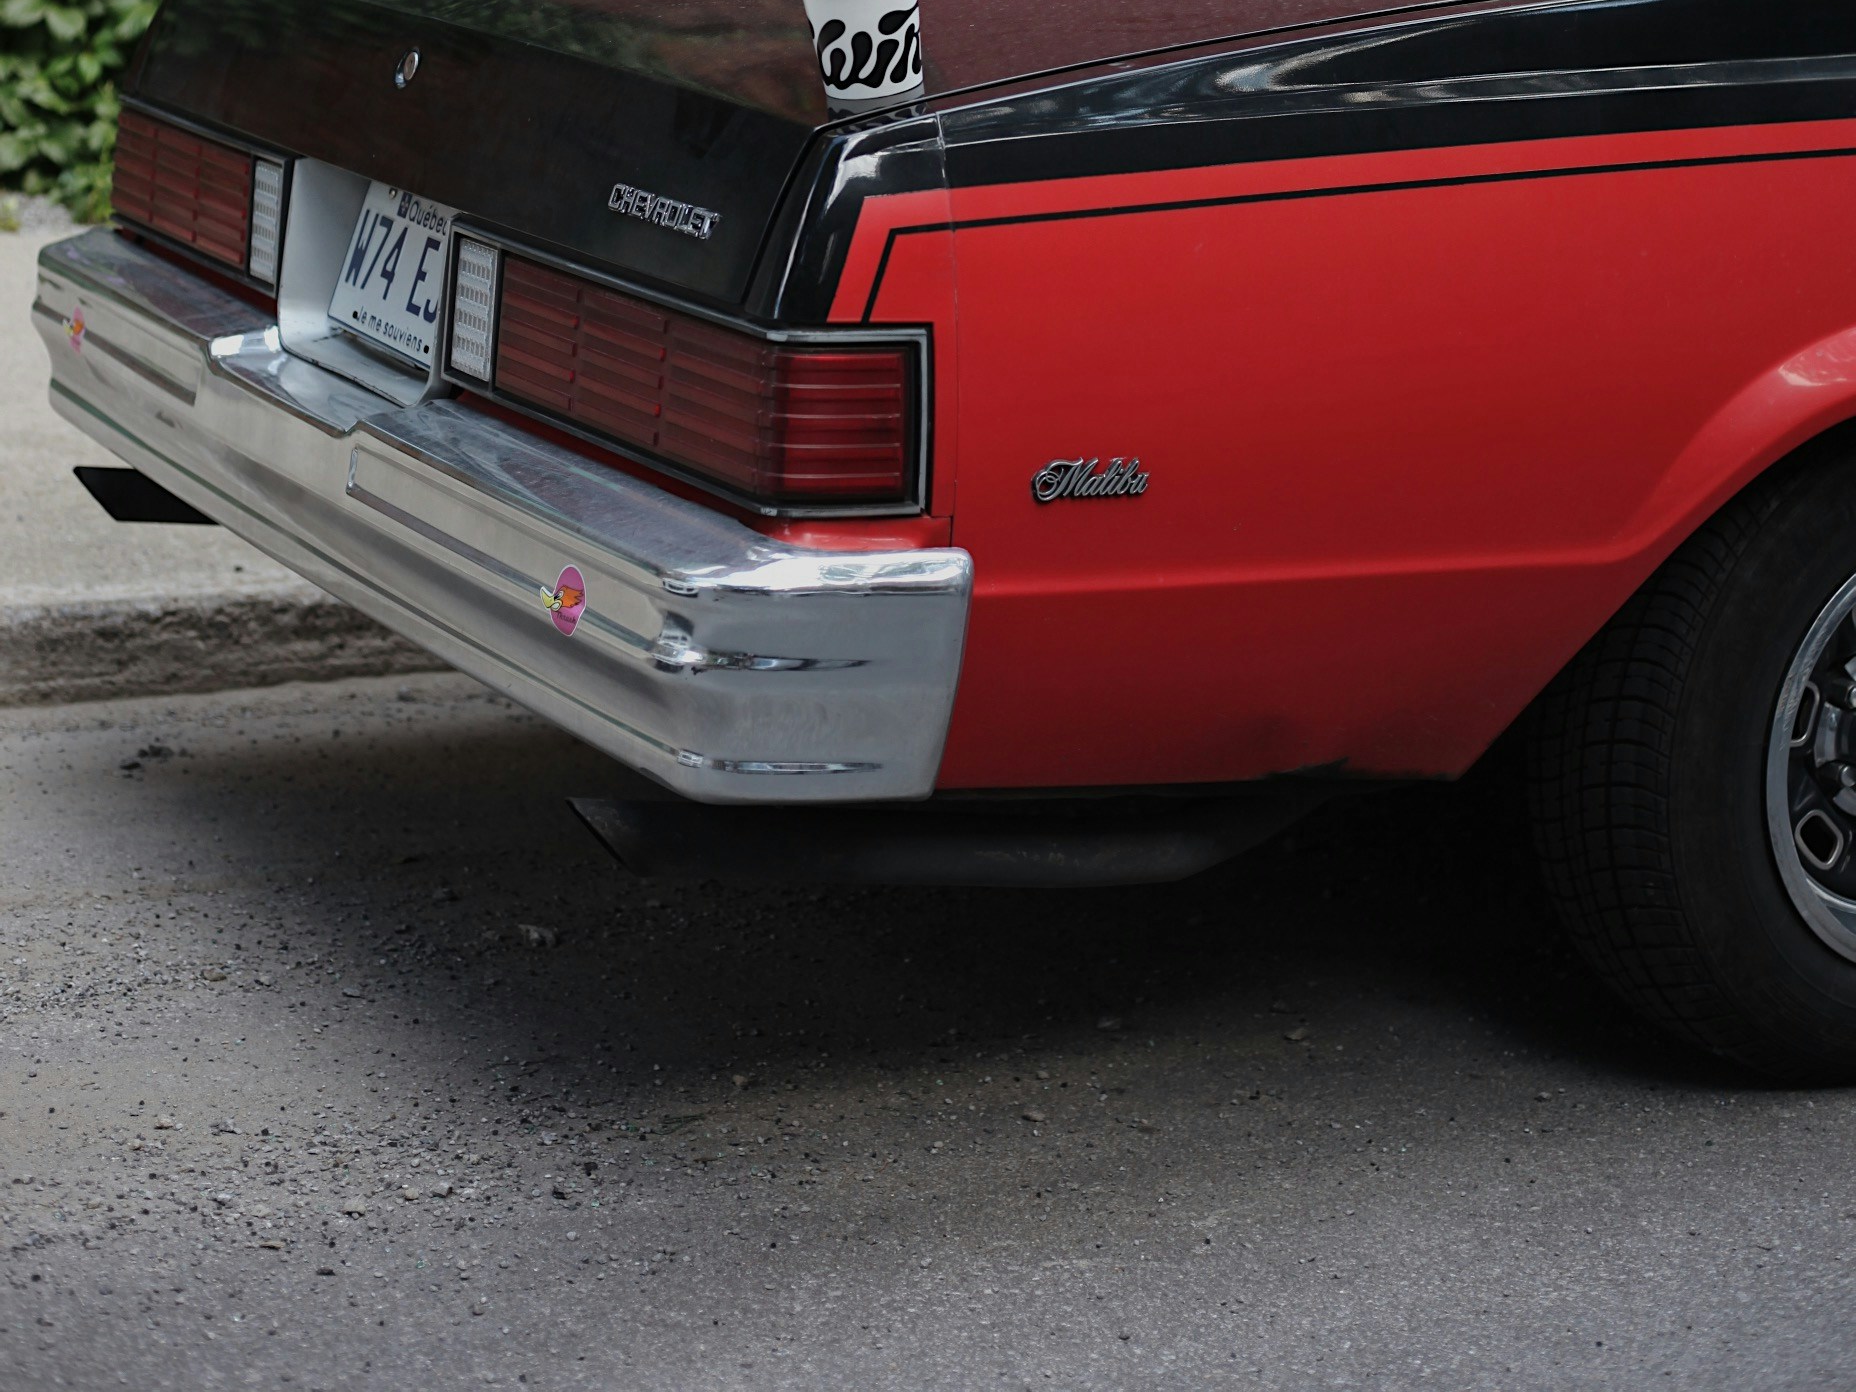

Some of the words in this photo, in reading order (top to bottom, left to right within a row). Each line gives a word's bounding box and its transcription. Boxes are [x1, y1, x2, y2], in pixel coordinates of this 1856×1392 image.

[608, 182, 721, 239] CHEVROLET
[345, 209, 409, 301] W74
[368, 313, 382, 331] me
[382, 323, 423, 352] souviens
[1031, 456, 1149, 501] Malibu
